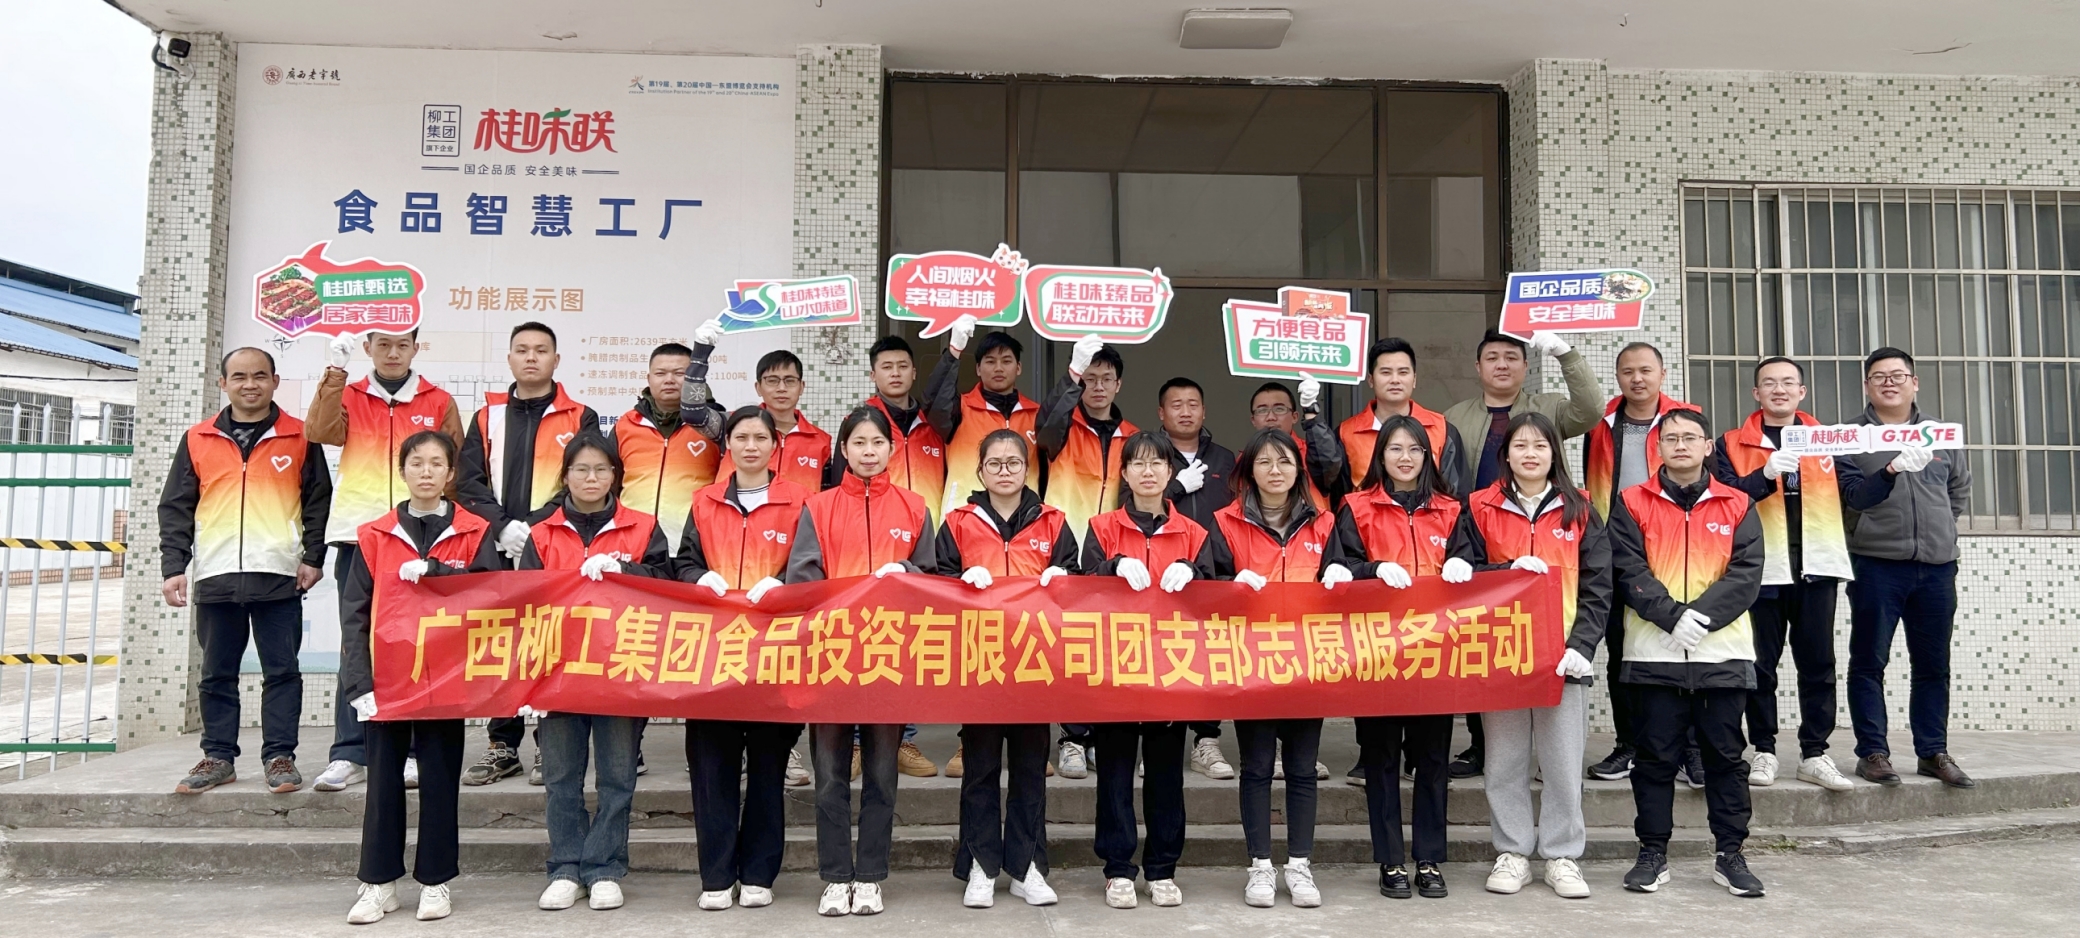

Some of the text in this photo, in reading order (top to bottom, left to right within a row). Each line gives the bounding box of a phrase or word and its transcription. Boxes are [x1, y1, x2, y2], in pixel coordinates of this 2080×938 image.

[427, 109, 457, 124] 柳工
[426, 124, 456, 139] 集团
[473, 107, 619, 155] 桂味联
[425, 144, 454, 153] 旗下企业
[464, 164, 578, 177] 国企品质 安全美味
[333, 189, 703, 240] 食品智慧工厂
[907, 264, 996, 287] 人间烟火
[322, 277, 409, 298] 桂味甄选
[781, 284, 847, 303] 桂味特造
[904, 286, 996, 310] 幸福桂味
[1053, 281, 1155, 304] 桂味臻品
[1519, 278, 1603, 299] 国企品质
[448, 286, 584, 312] 功能展示图
[782, 298, 848, 319] 山水味道
[322, 304, 413, 324] 居家美味
[1051, 304, 1146, 325] 联动未来
[1528, 302, 1617, 324] 安全美味
[1252, 317, 1346, 342] 方便食品
[1258, 341, 1342, 364] 引领未来
[706, 371, 748, 381] :1100吨
[599, 415, 622, 425] 目新
[1810, 428, 1860, 445] 桂味联
[1881, 425, 1956, 448] G.TASTE
[410, 600, 1536, 687] 广西柳工集团食品投资有限公司团支部志愿服务活动
